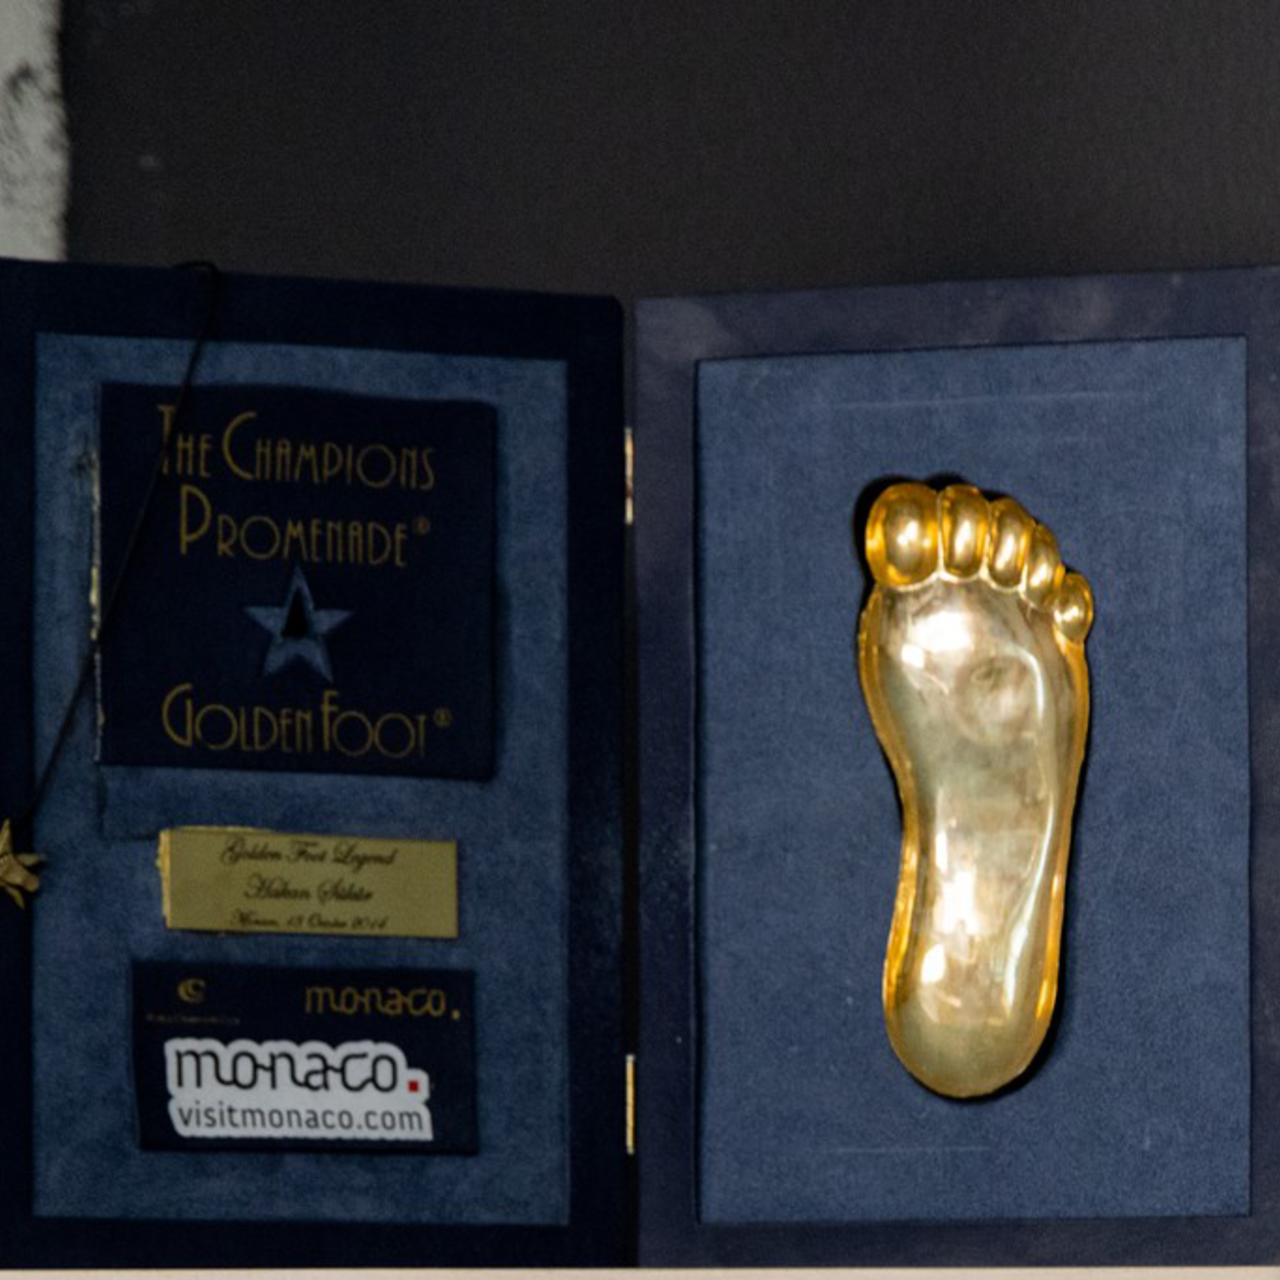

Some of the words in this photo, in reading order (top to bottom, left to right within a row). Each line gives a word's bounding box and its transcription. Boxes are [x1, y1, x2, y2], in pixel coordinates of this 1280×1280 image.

[221, 410, 436, 491] CHAMPIONS
[174, 1048, 419, 1093] monaco.
[177, 1100, 424, 1132] visitmonaco.com
